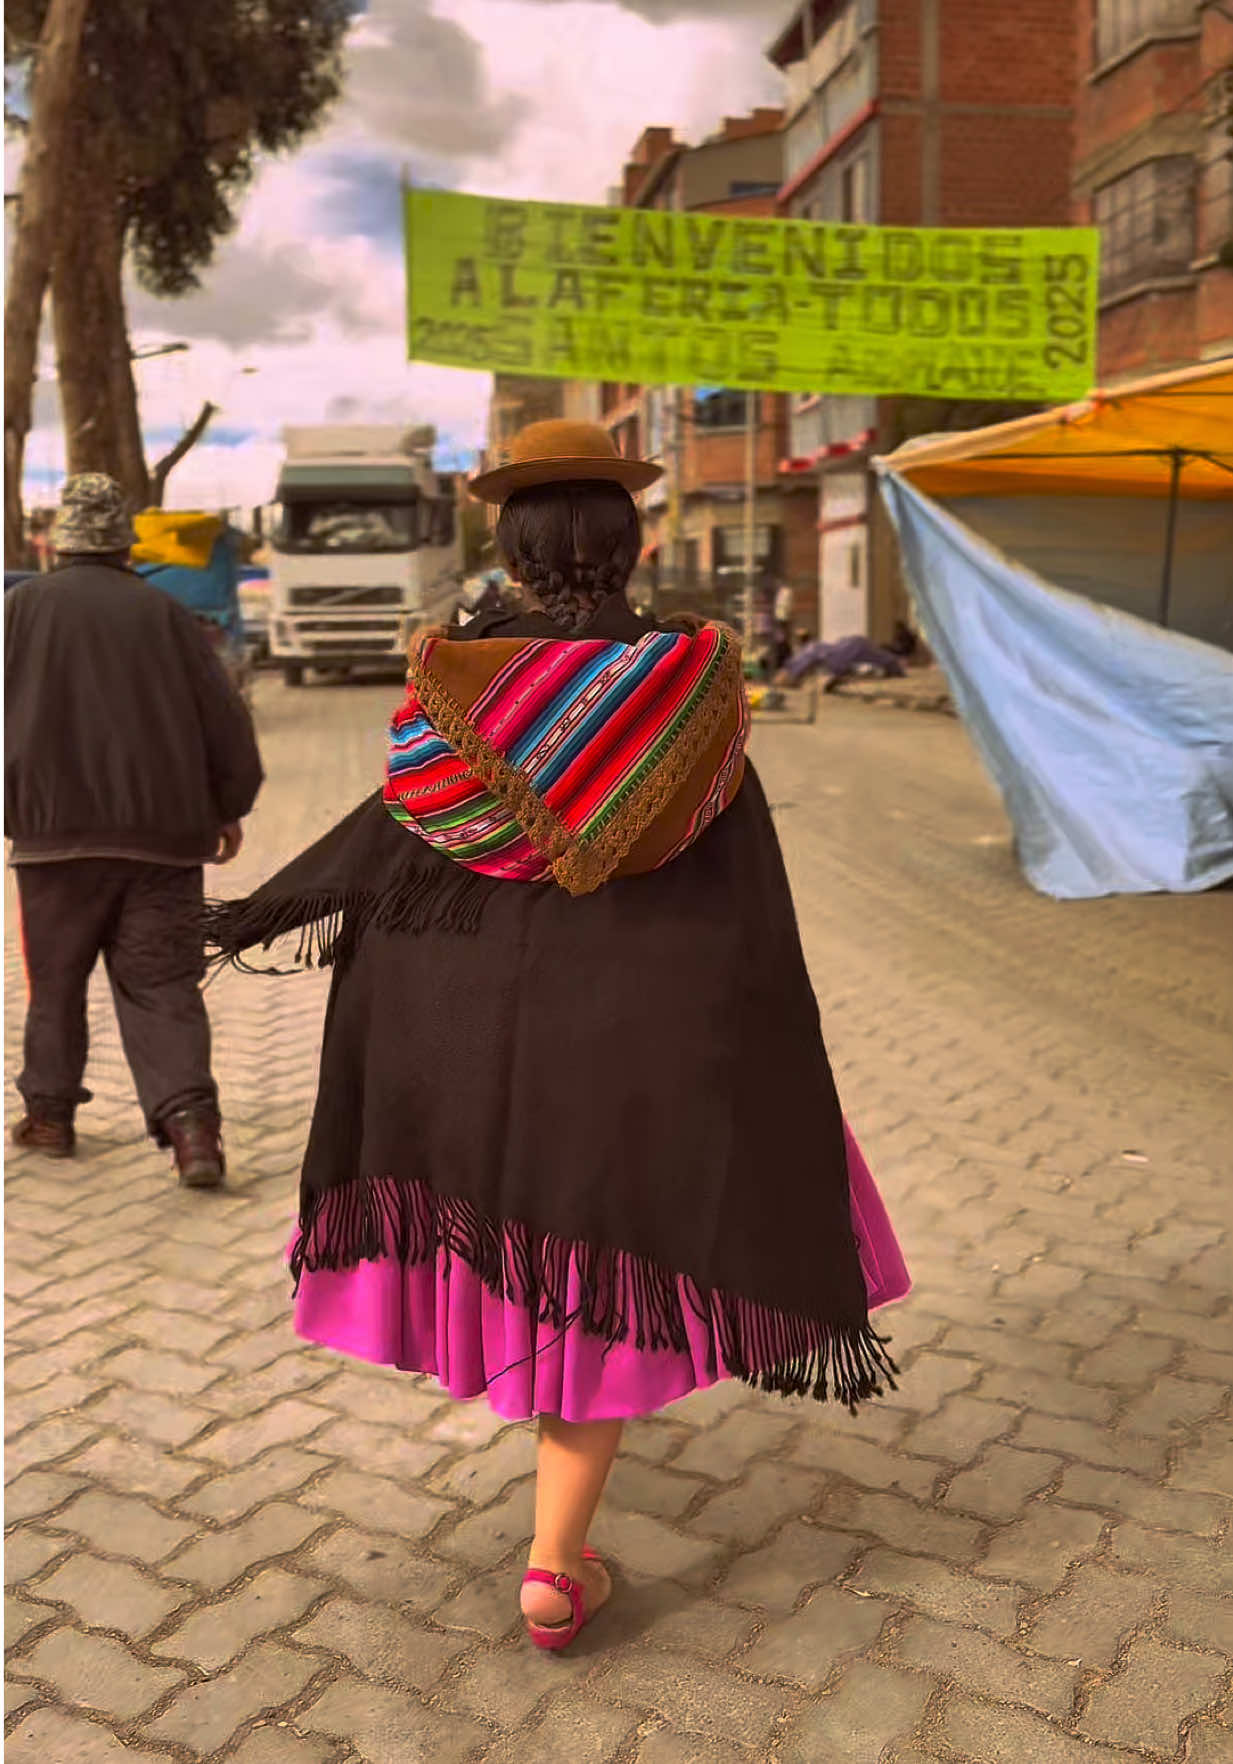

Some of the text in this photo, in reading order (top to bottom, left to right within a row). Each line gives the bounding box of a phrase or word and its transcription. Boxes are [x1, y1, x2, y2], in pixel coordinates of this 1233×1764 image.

[451, 257, 482, 308] A
[484, 203, 1023, 286] BIENVENIDOS
[1042, 253, 1090, 371] 2025
